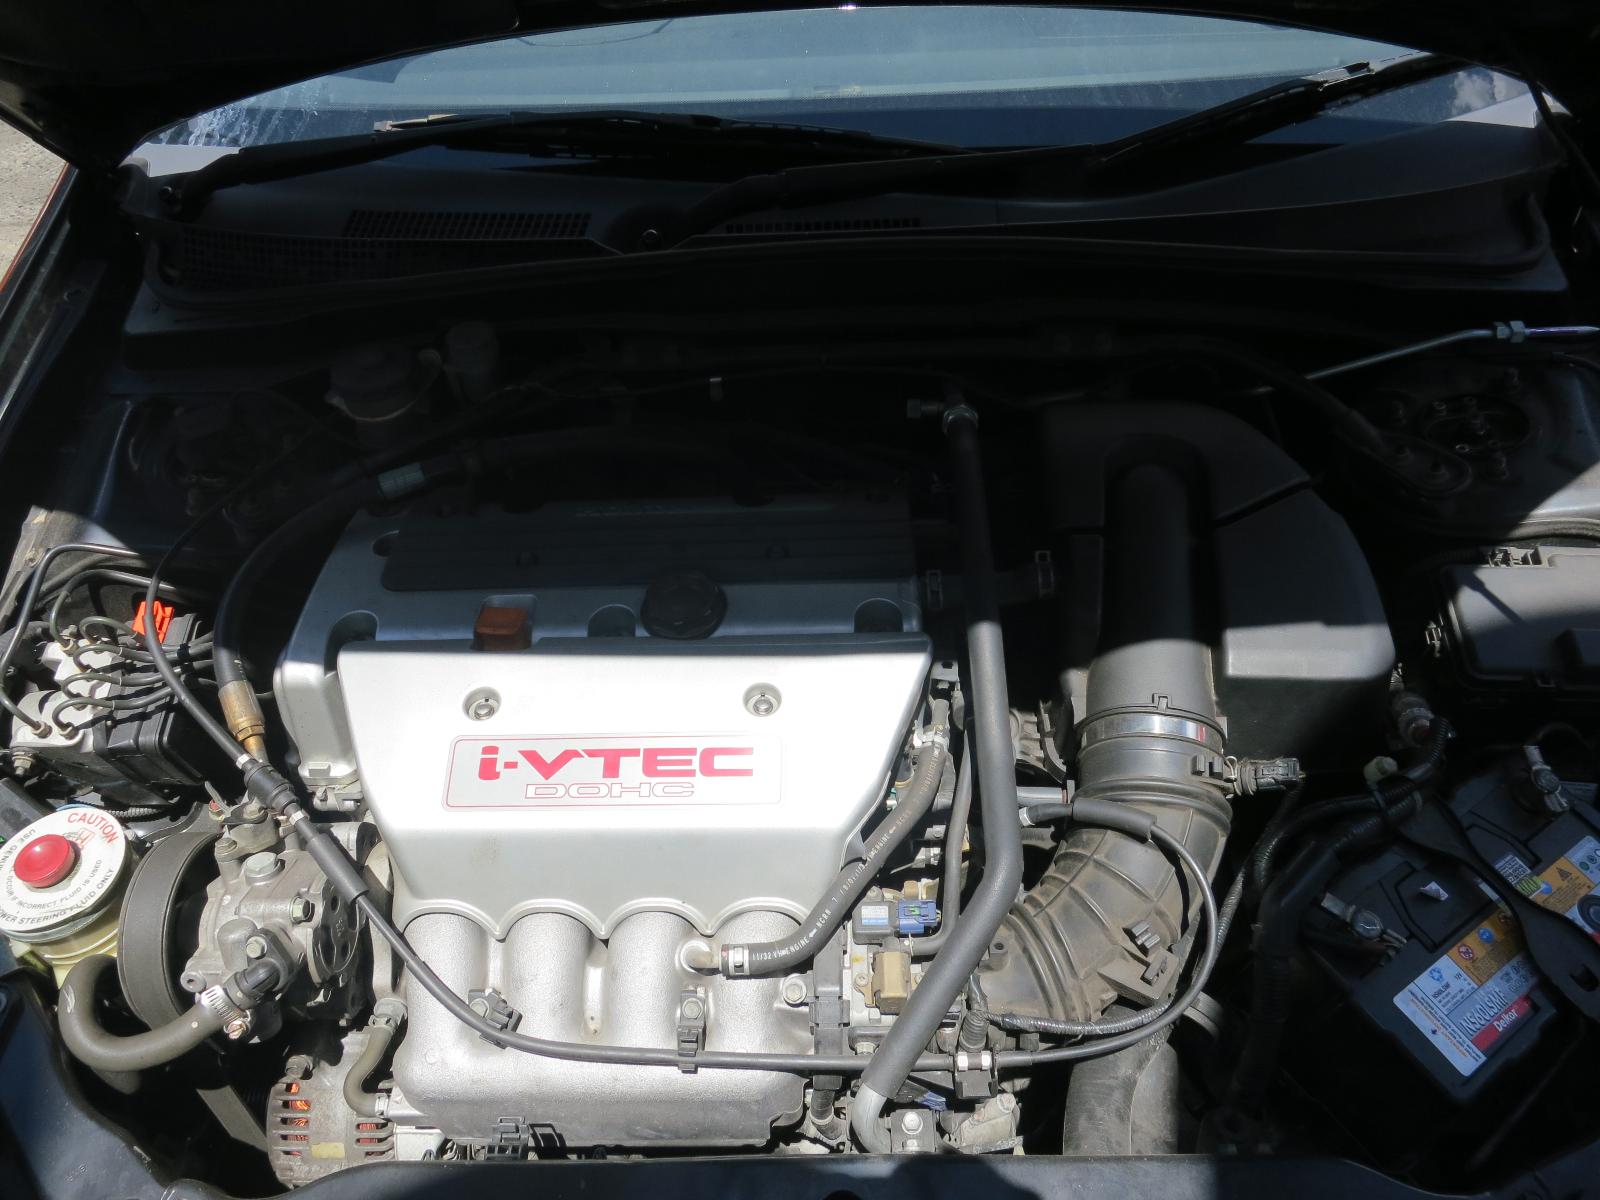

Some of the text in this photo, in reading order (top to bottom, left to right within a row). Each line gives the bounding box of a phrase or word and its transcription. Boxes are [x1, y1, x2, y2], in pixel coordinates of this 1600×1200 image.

[524, 781, 695, 799] DOHC
[67, 812, 118, 844] CAUTION
[90, 859, 102, 878] USED
[18, 907, 67, 925] STEERING
[96, 868, 115, 890] ONLY
[1492, 1008, 1519, 1032] Delkor
